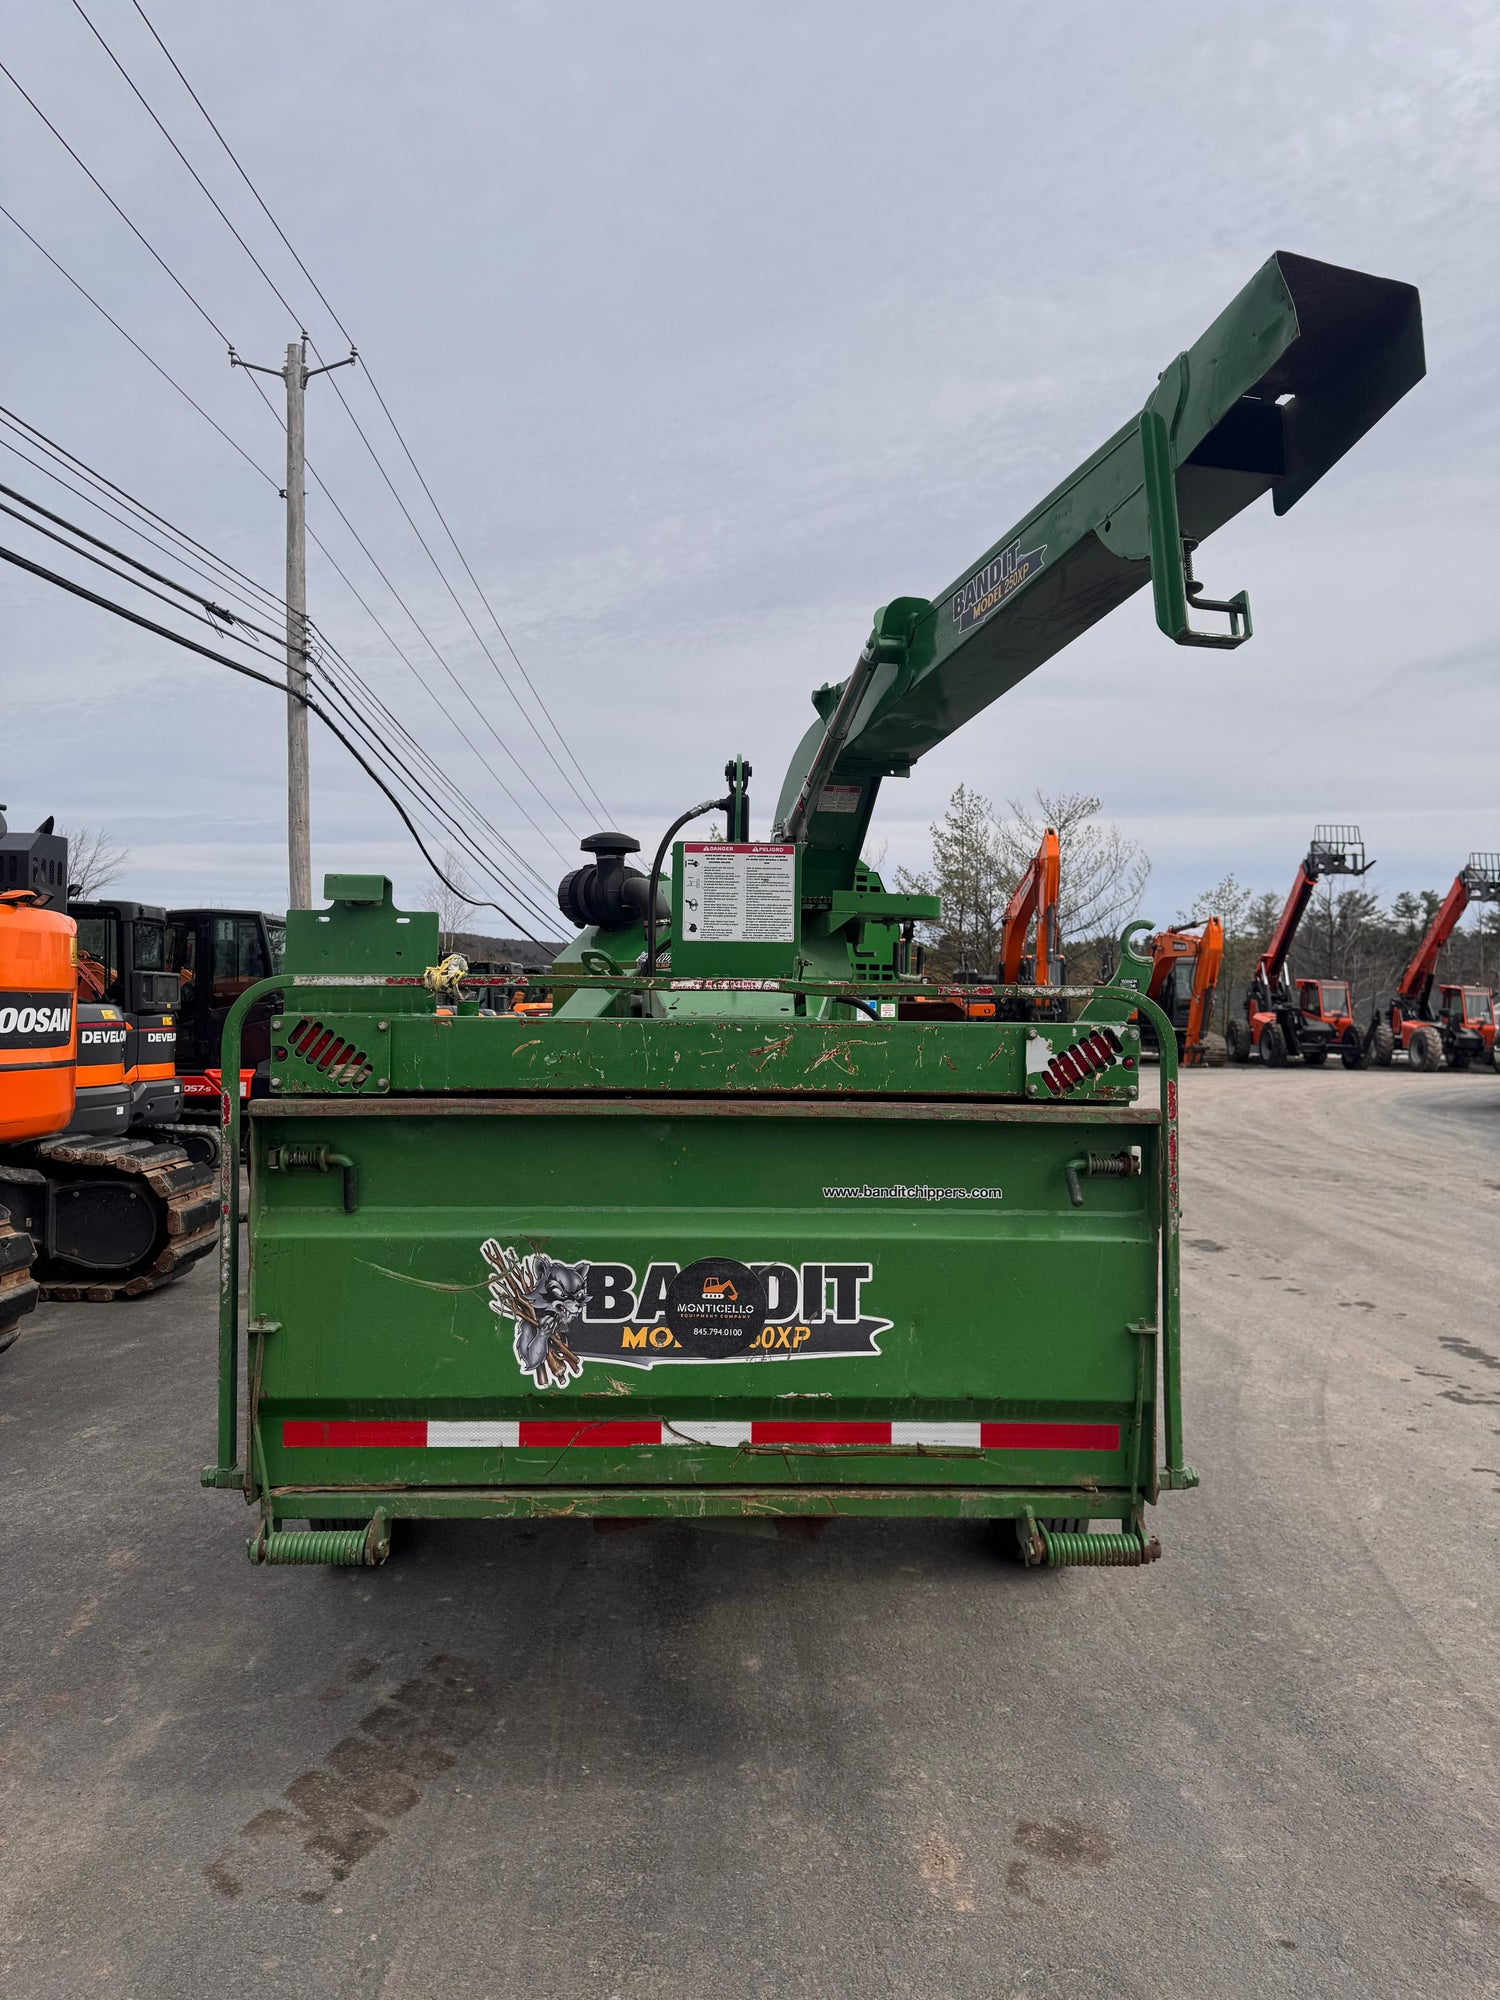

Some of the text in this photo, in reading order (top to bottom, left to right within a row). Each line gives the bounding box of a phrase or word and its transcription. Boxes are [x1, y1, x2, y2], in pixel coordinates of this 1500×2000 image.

[953, 539, 1020, 621] BANDIT
[973, 562, 1029, 619] MODEL 250XP
[0, 1007, 71, 1034] OOSAN
[81, 1030, 127, 1044] DEVELO
[147, 1033, 177, 1043] DEVELO
[823, 1185, 1002, 1200] www.banditchippers.com
[584, 1262, 872, 1323] BADIT
[677, 1303, 754, 1314] MONTICELLO
[693, 1327, 743, 1337] 845.794.0100
[749, 1326, 811, 1349] 0XP
